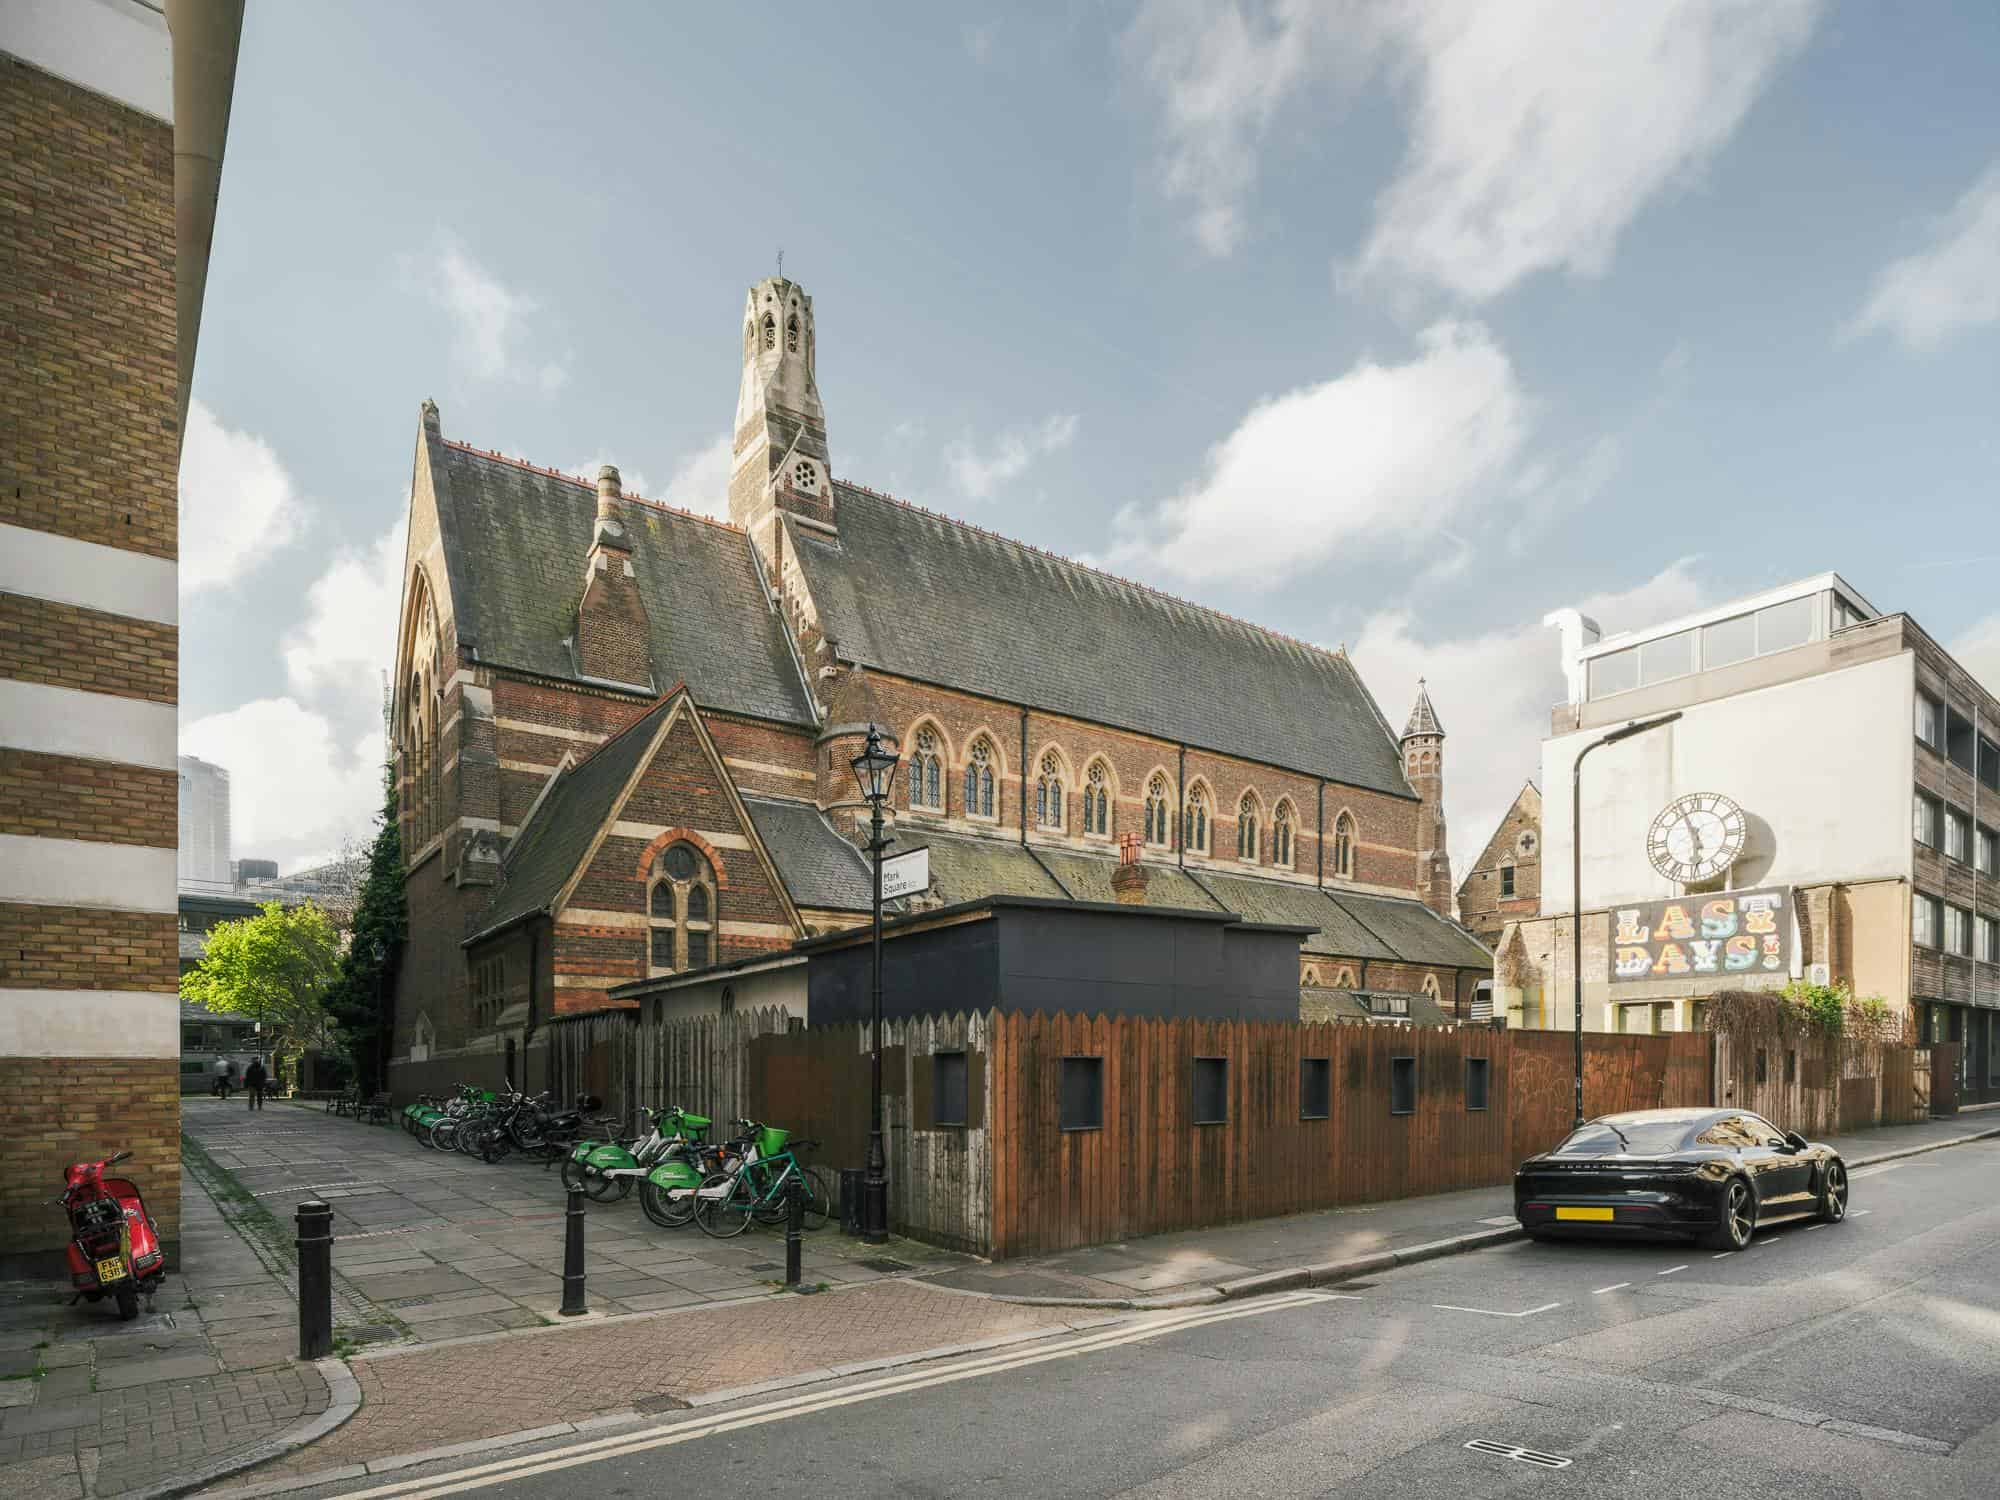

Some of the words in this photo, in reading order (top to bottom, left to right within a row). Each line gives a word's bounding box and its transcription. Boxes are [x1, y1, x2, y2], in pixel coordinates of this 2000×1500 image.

[884, 871, 899, 881] Mark
[884, 881, 906, 895] Square
[1615, 895, 1782, 945] LAST
[1615, 935, 1781, 976] DAYS!
